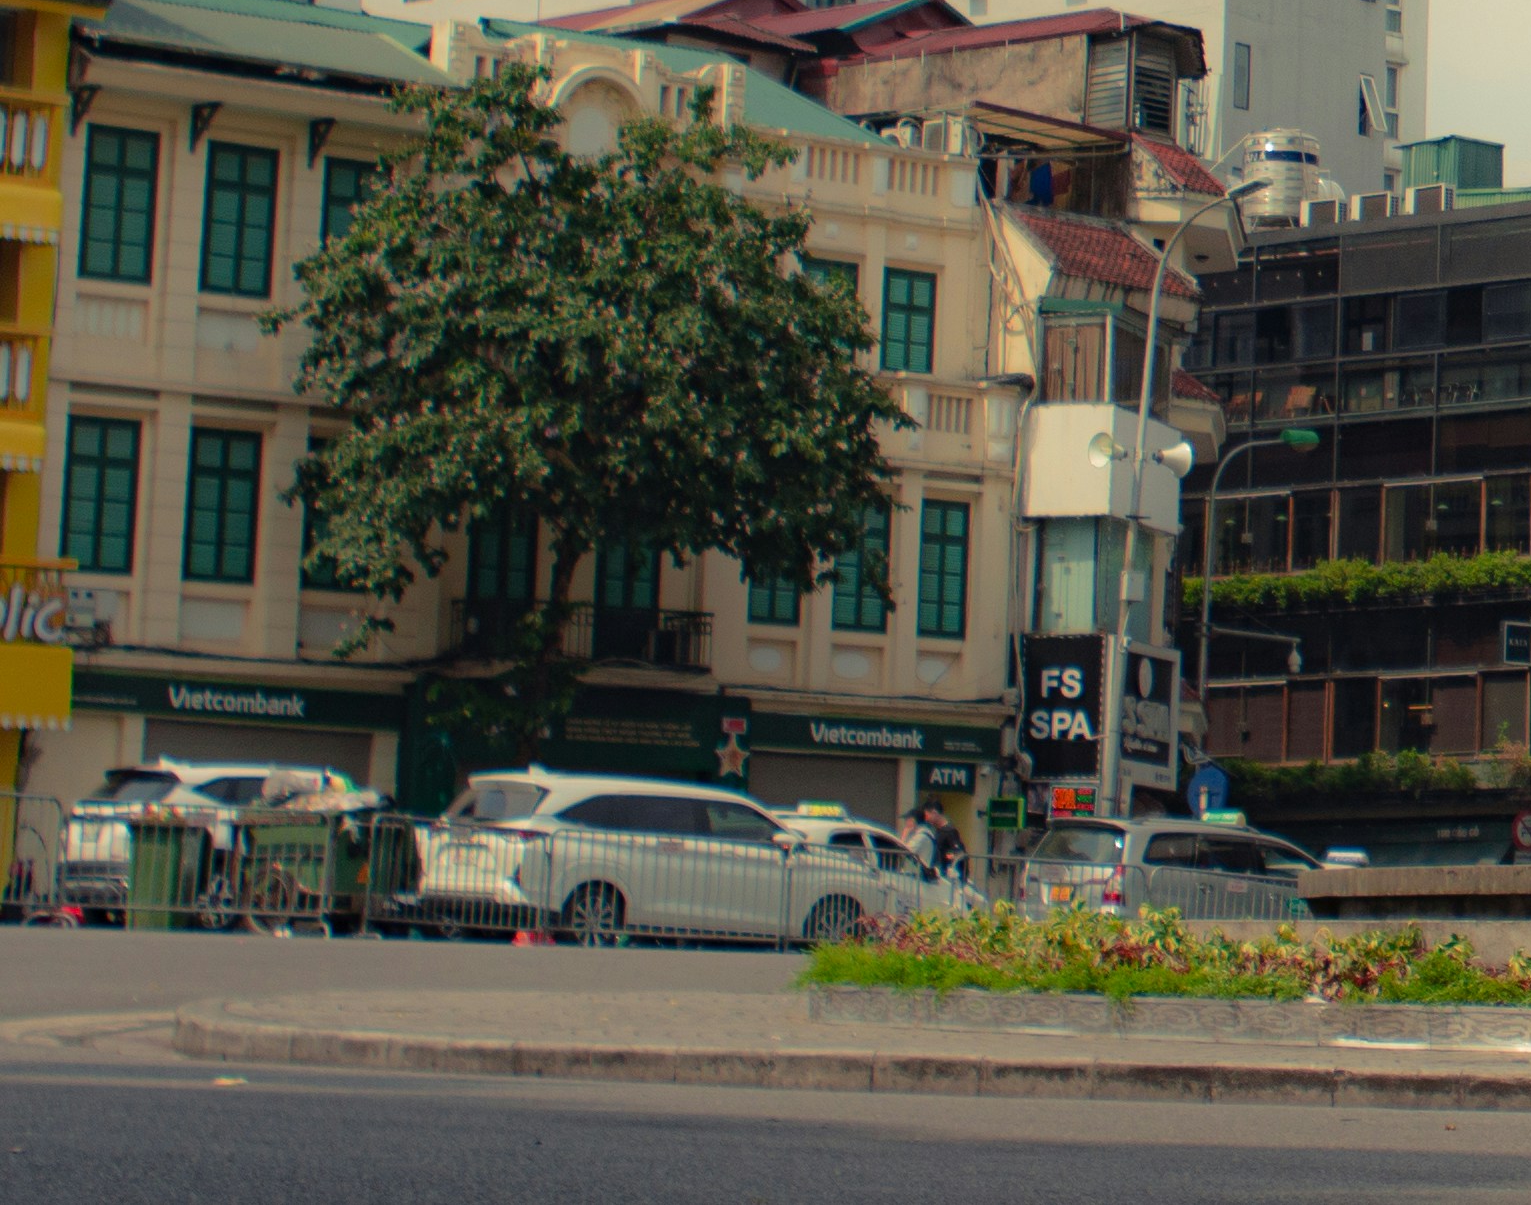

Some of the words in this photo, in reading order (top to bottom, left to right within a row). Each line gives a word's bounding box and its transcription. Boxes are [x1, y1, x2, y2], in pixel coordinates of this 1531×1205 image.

[1041, 669, 1083, 699] FS
[168, 683, 305, 717] Vietcombank
[810, 721, 924, 750] Vietcombank
[1030, 710, 1092, 741] SPA
[929, 767, 966, 787] ATM
